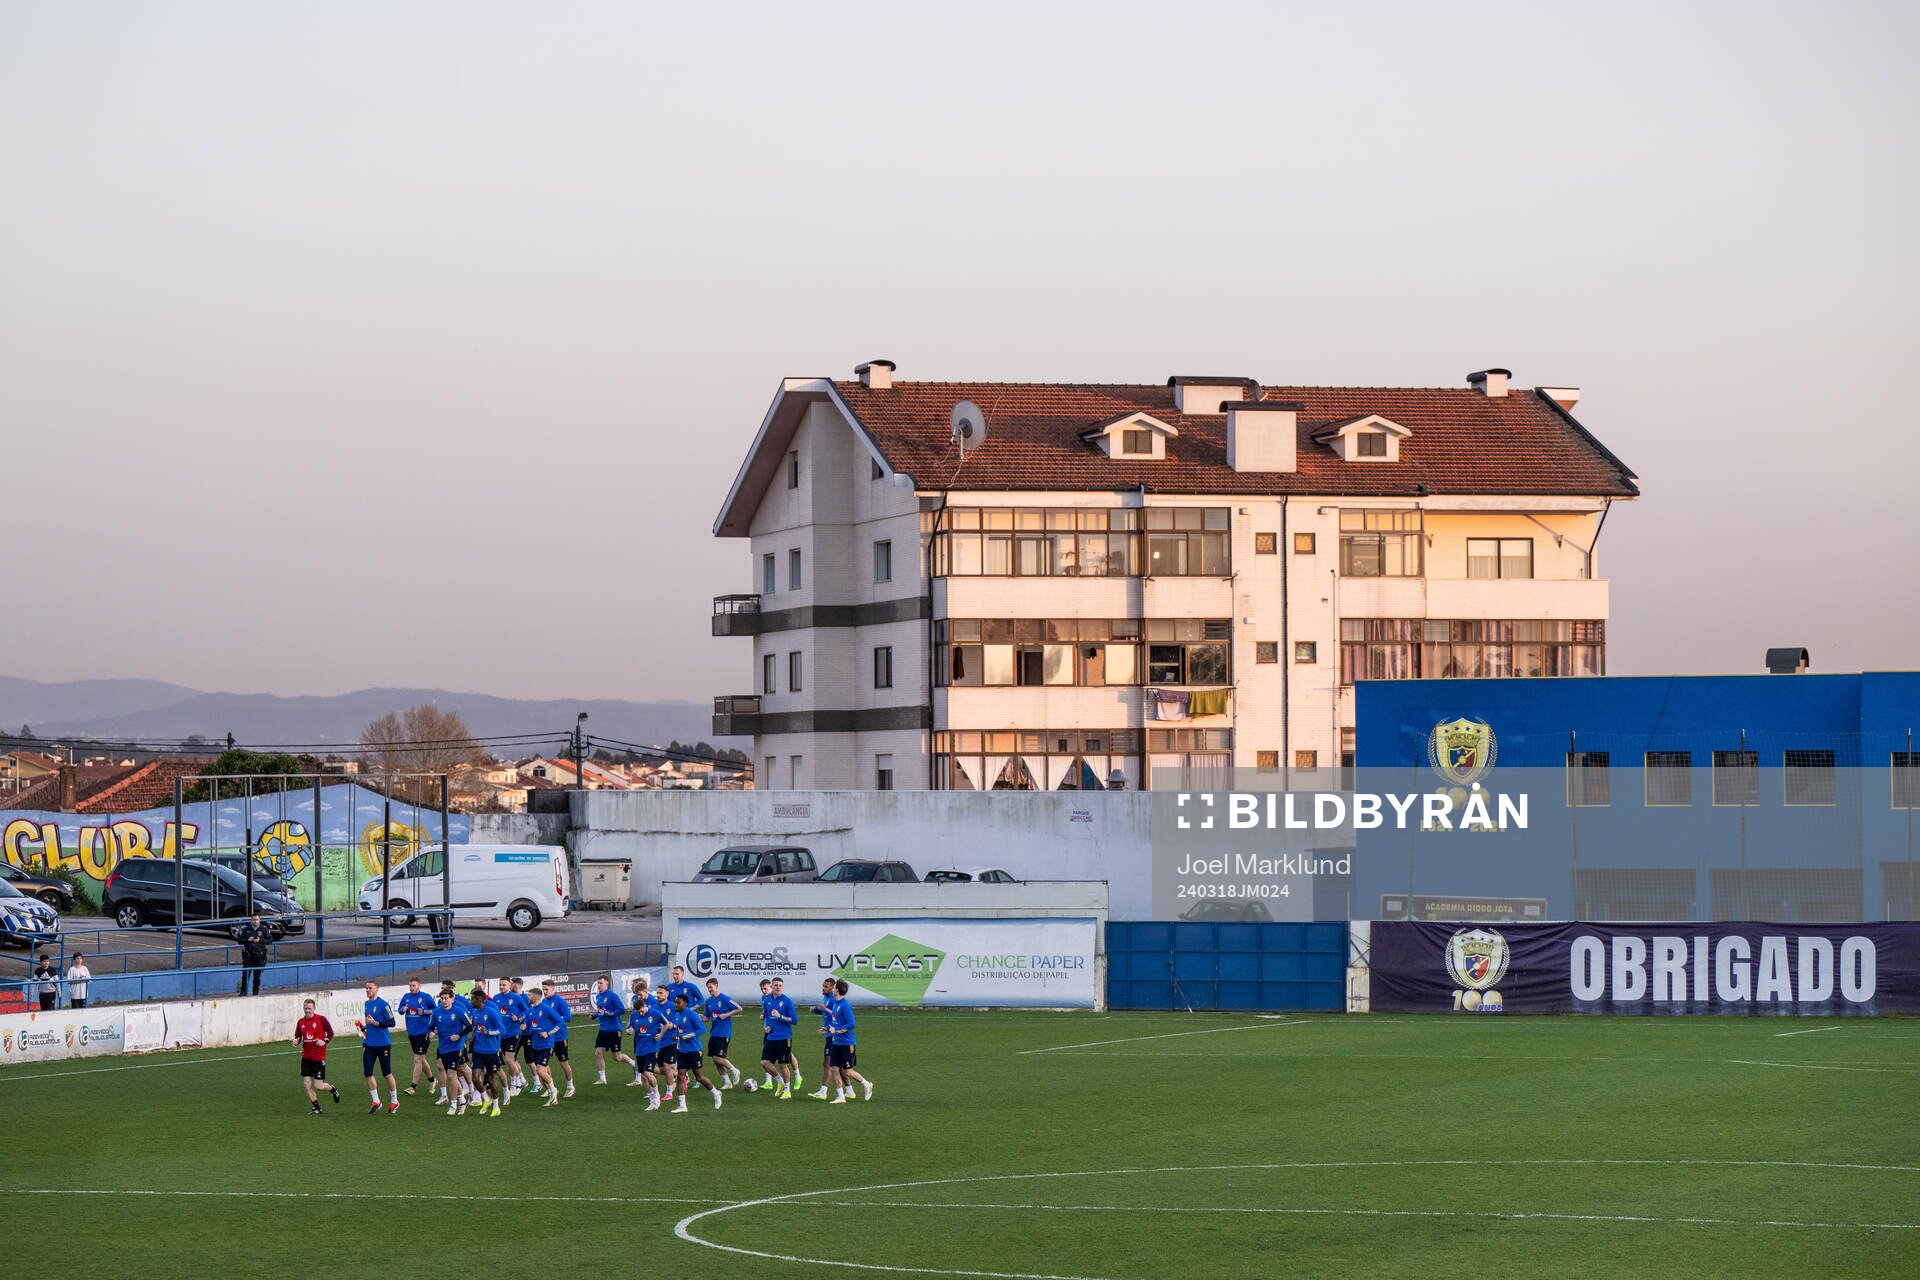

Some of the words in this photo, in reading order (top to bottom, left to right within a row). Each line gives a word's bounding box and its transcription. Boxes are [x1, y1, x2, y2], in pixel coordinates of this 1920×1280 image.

[1425, 903, 1466, 912] ACADEMIA
[1467, 903, 1492, 913] DIOGO
[1493, 905, 1513, 913] JOTA
[719, 952, 773, 961] AZEVEDO
[956, 954, 1027, 969] CHANGE
[1031, 955, 1084, 969] PAPER
[719, 962, 807, 971] ALBUQUERQUE
[817, 954, 939, 972] UVPLAST
[1570, 935, 1877, 1002] OBRIGADO
[971, 970, 1031, 980] DISTRIBUIÇÃO
[1046, 971, 1069, 979] PAPEL
